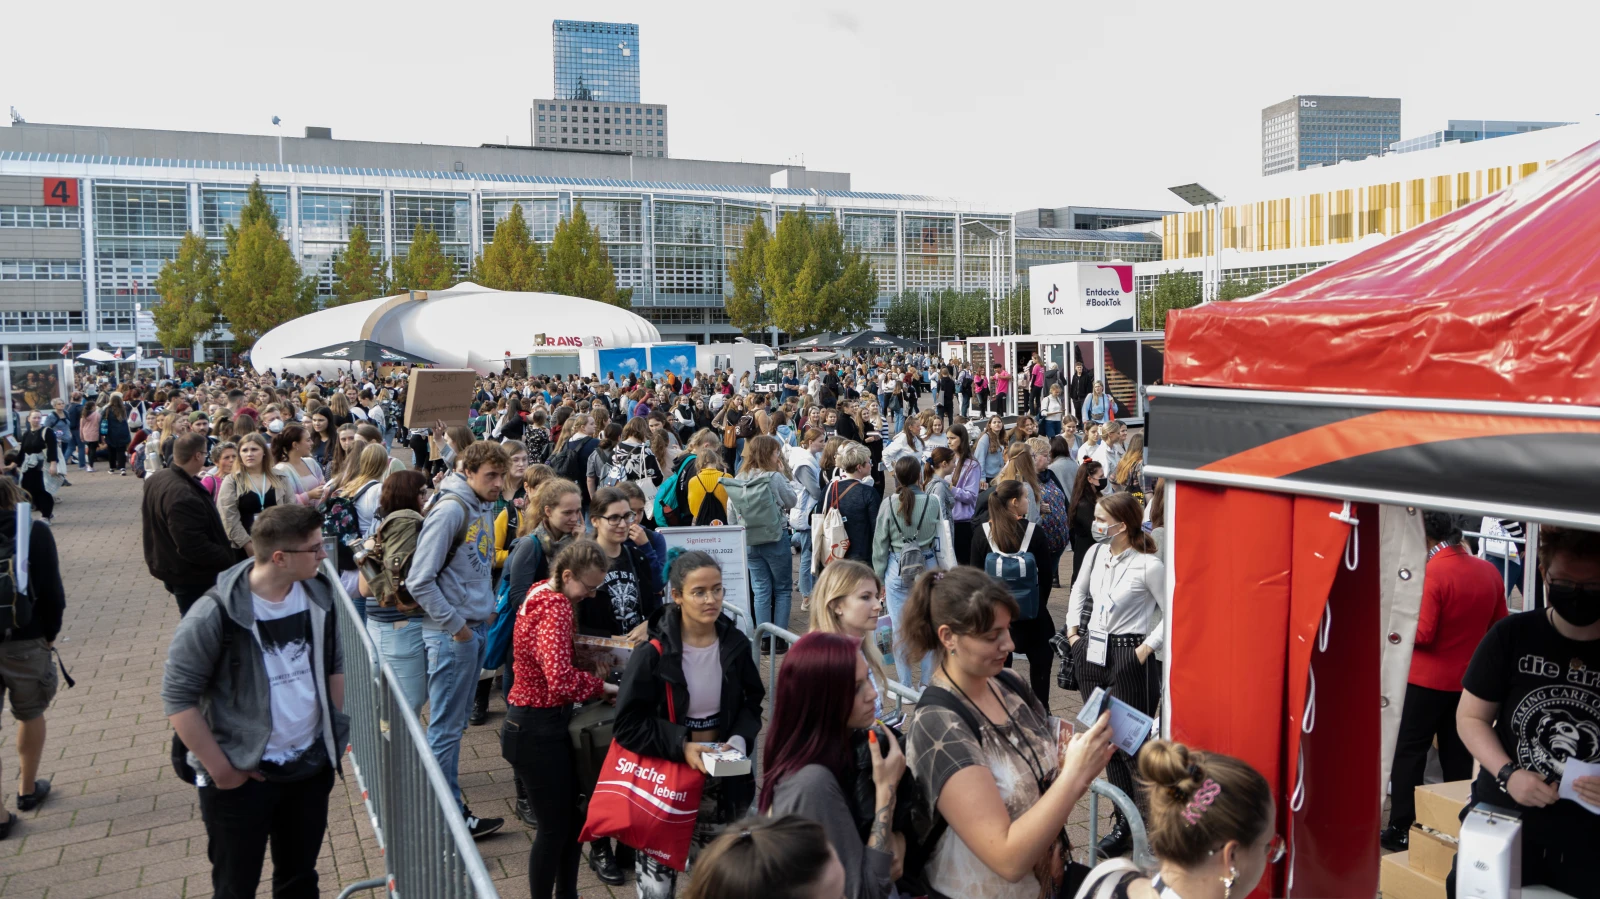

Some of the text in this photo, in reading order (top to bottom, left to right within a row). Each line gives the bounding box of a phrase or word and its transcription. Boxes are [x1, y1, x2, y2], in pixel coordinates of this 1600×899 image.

[1300, 98, 1317, 108] ibc
[51, 180, 70, 203] 4
[1043, 307, 1064, 316] TikTok
[1518, 654, 1560, 678] die
[1514, 690, 1546, 725] TAKING
[1550, 688, 1589, 702] CARE
[615, 758, 666, 784] Sprache
[653, 784, 687, 802] leben!
